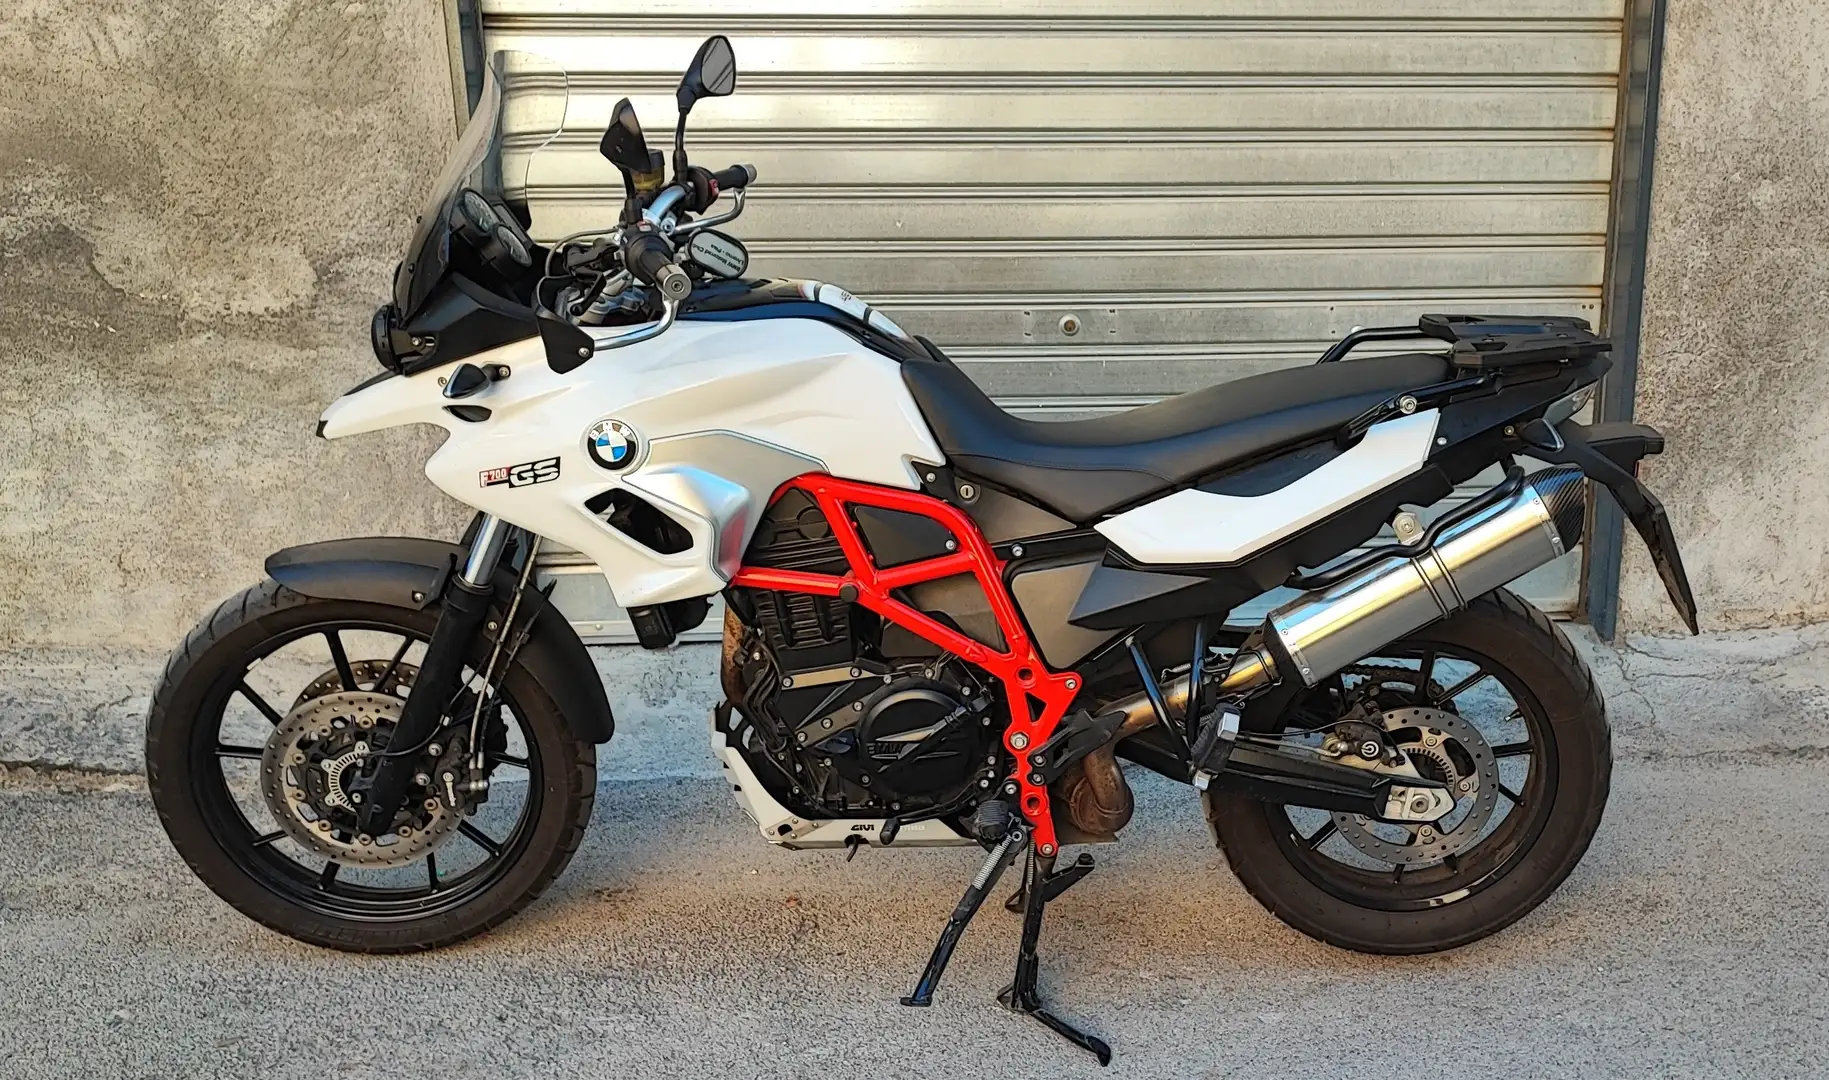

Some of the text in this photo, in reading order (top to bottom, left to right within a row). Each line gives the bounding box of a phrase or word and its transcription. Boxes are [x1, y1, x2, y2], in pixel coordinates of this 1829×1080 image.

[704, 249, 728, 264] Motorrad
[727, 260, 741, 272] BMW
[589, 421, 631, 441] BMW
[867, 742, 902, 754] BMW
